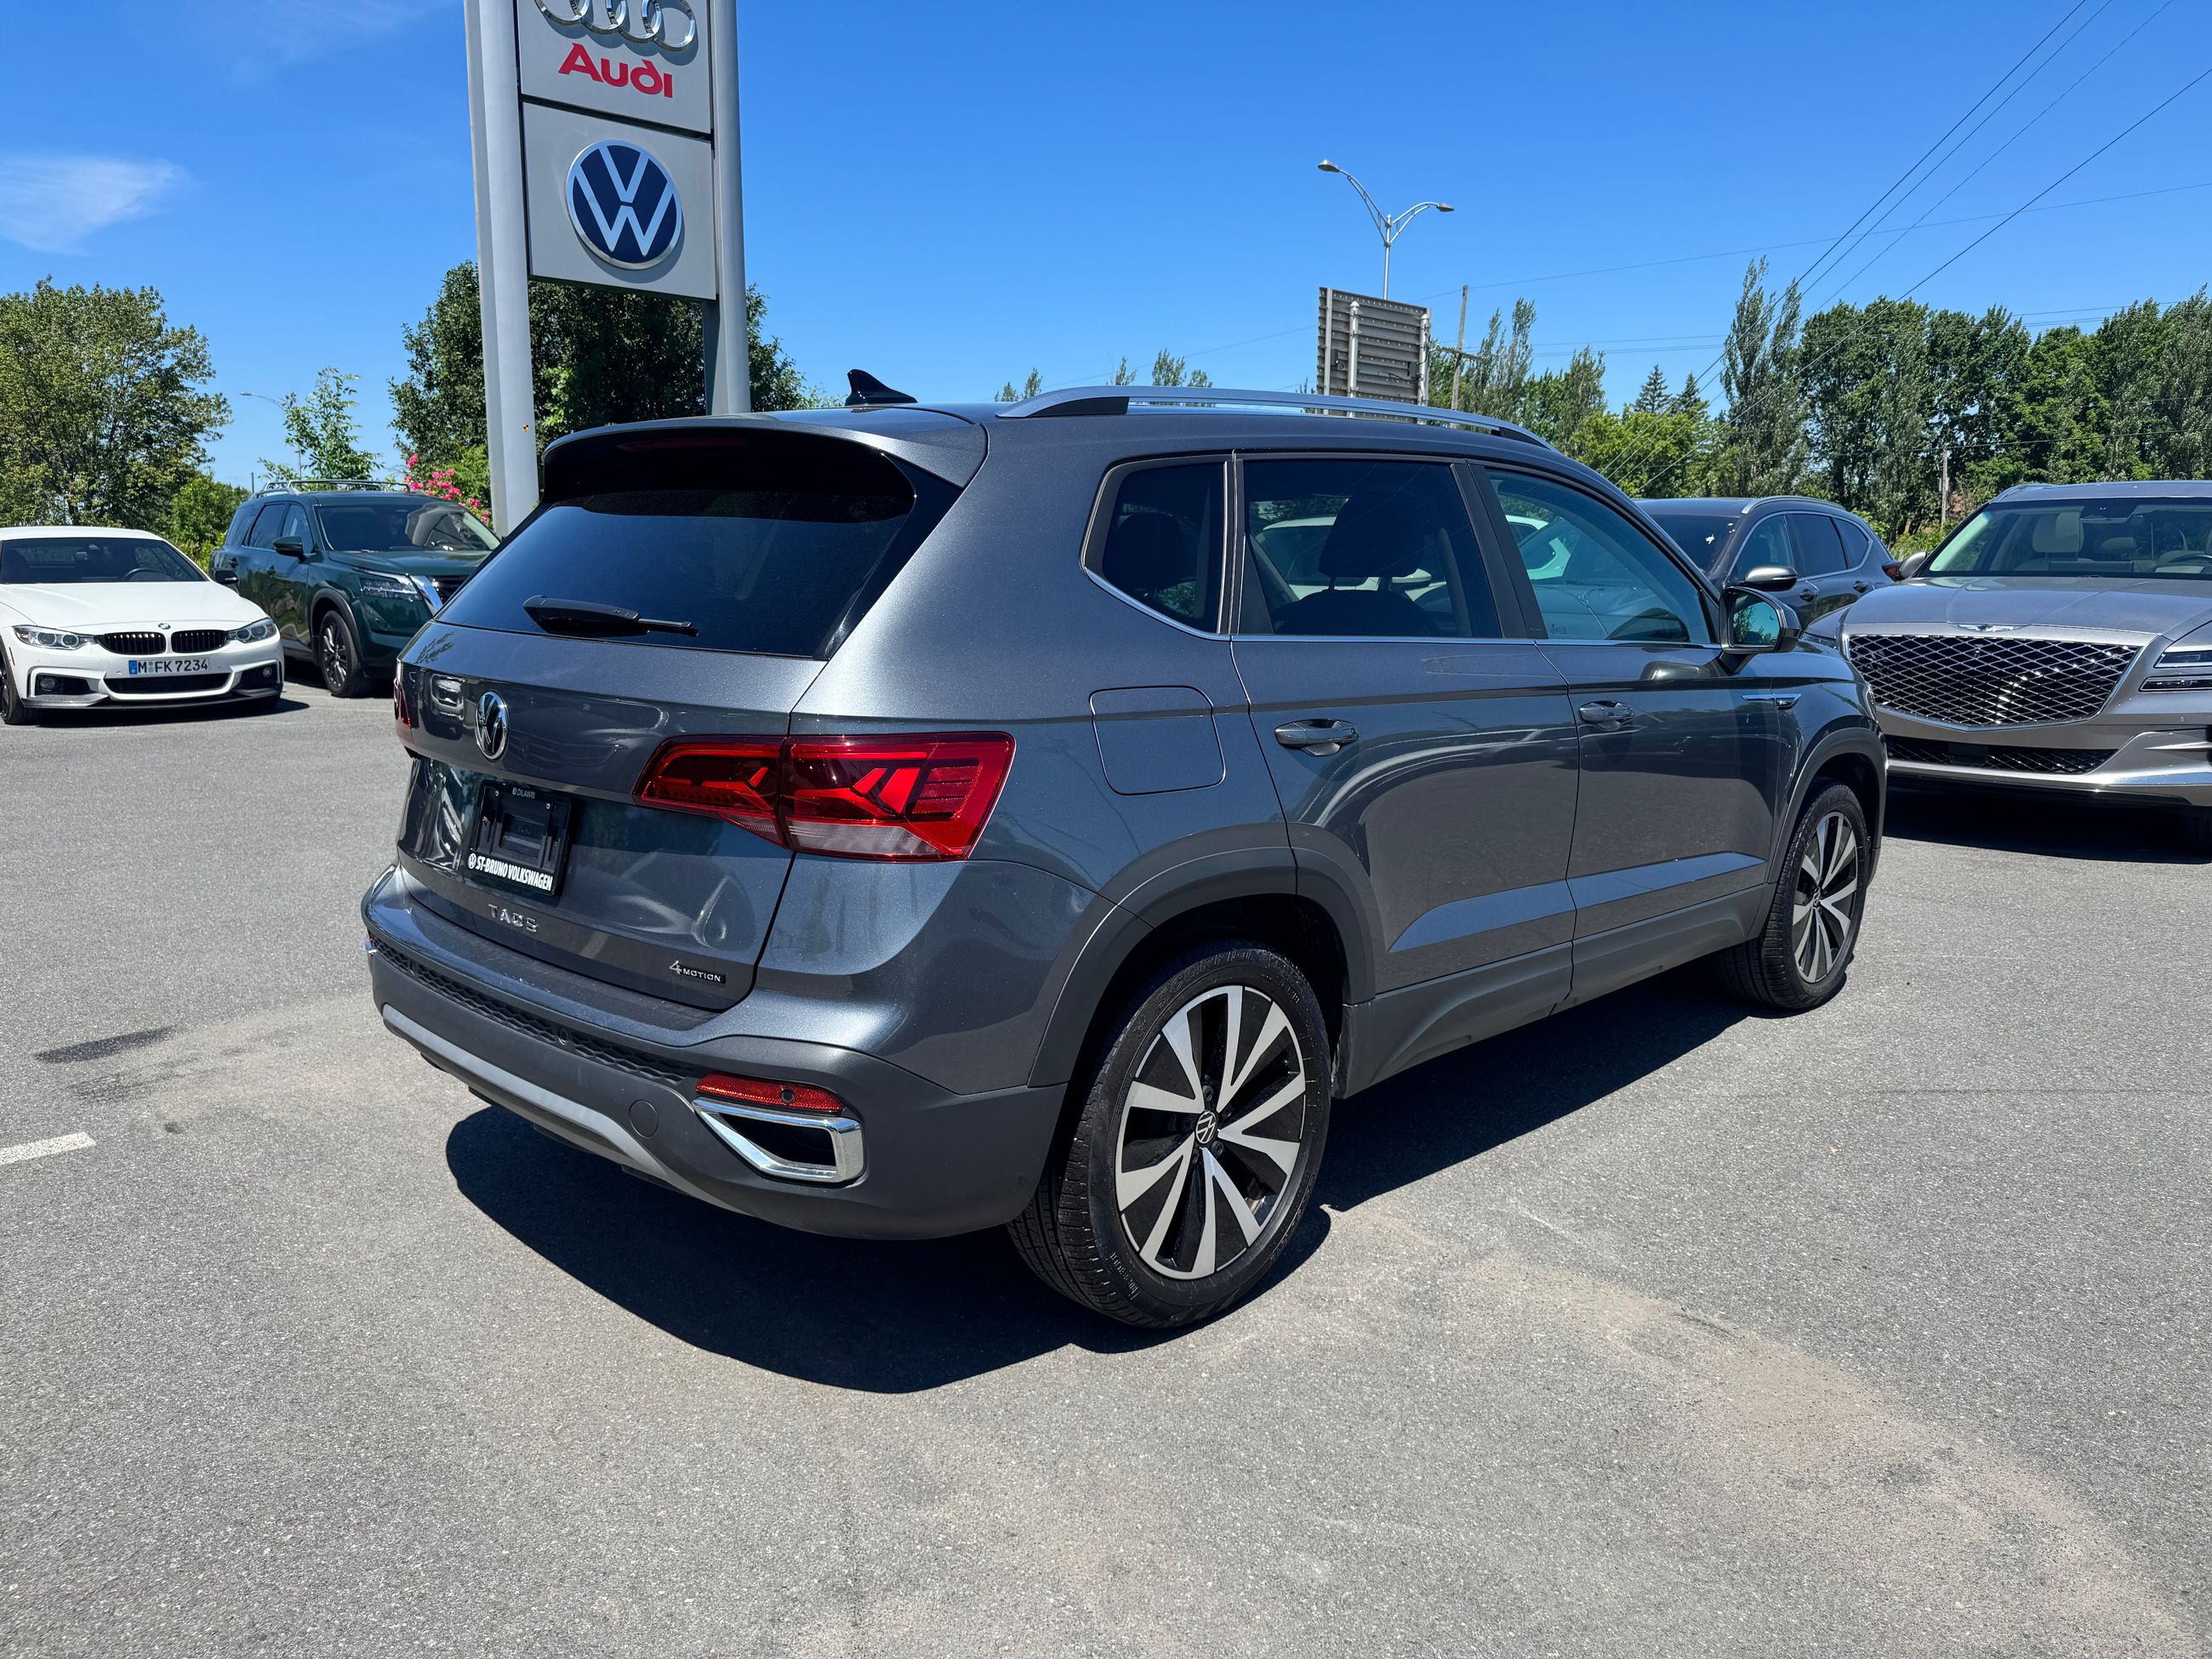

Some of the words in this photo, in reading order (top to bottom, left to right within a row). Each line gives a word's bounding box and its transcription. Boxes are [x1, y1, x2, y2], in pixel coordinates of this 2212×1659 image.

[558, 43, 673, 99] Audi
[571, 144, 679, 258] VW
[138, 662, 147, 673] M
[155, 661, 173, 673] FK
[175, 658, 208, 672] 7234
[476, 855, 509, 878] ST-BRUNO
[507, 864, 554, 892] VOLKSWAGEN
[487, 904, 538, 932] TAOS
[669, 960, 721, 983] 4MOTION
